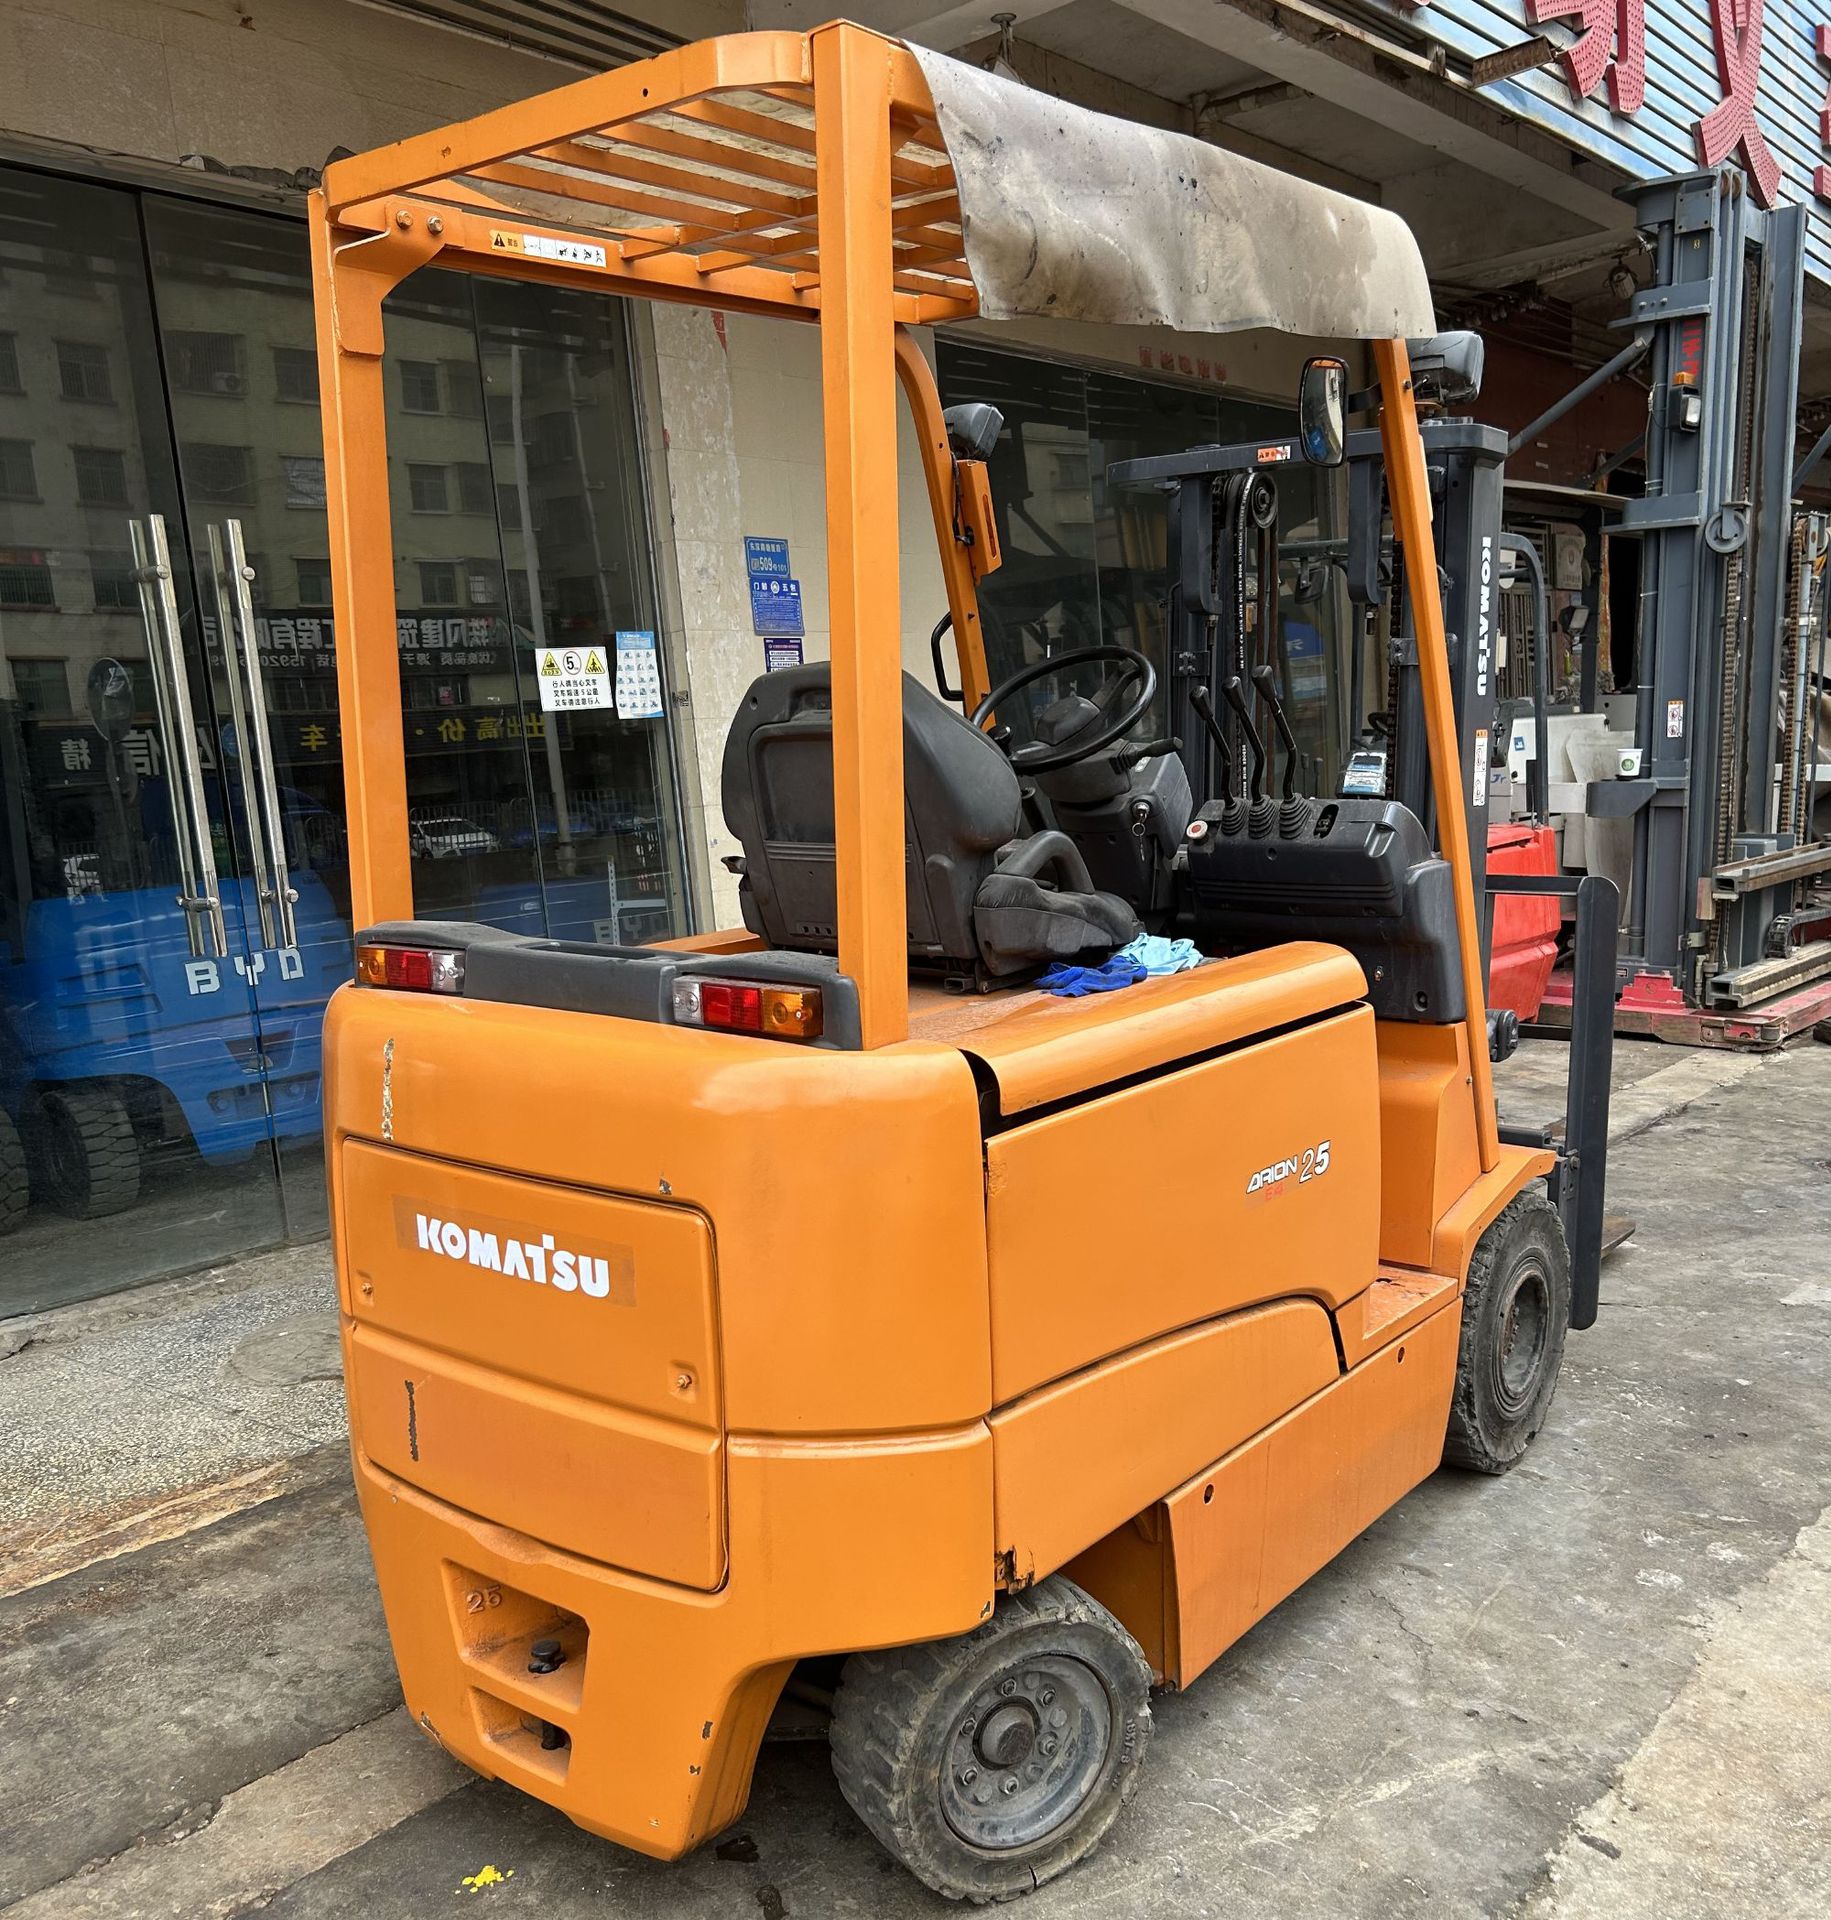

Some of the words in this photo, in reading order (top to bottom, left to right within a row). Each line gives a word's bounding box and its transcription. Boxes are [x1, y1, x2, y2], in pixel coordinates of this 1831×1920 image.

[1477, 536, 1492, 696] KOMATSU
[566, 656, 575, 670] 5
[184, 946, 305, 996] BYD
[1246, 1155, 1298, 1194] ARION
[1299, 1140, 1331, 1184] 25
[416, 1213, 611, 1298] KOMATSU
[466, 1584, 503, 1614] 25
